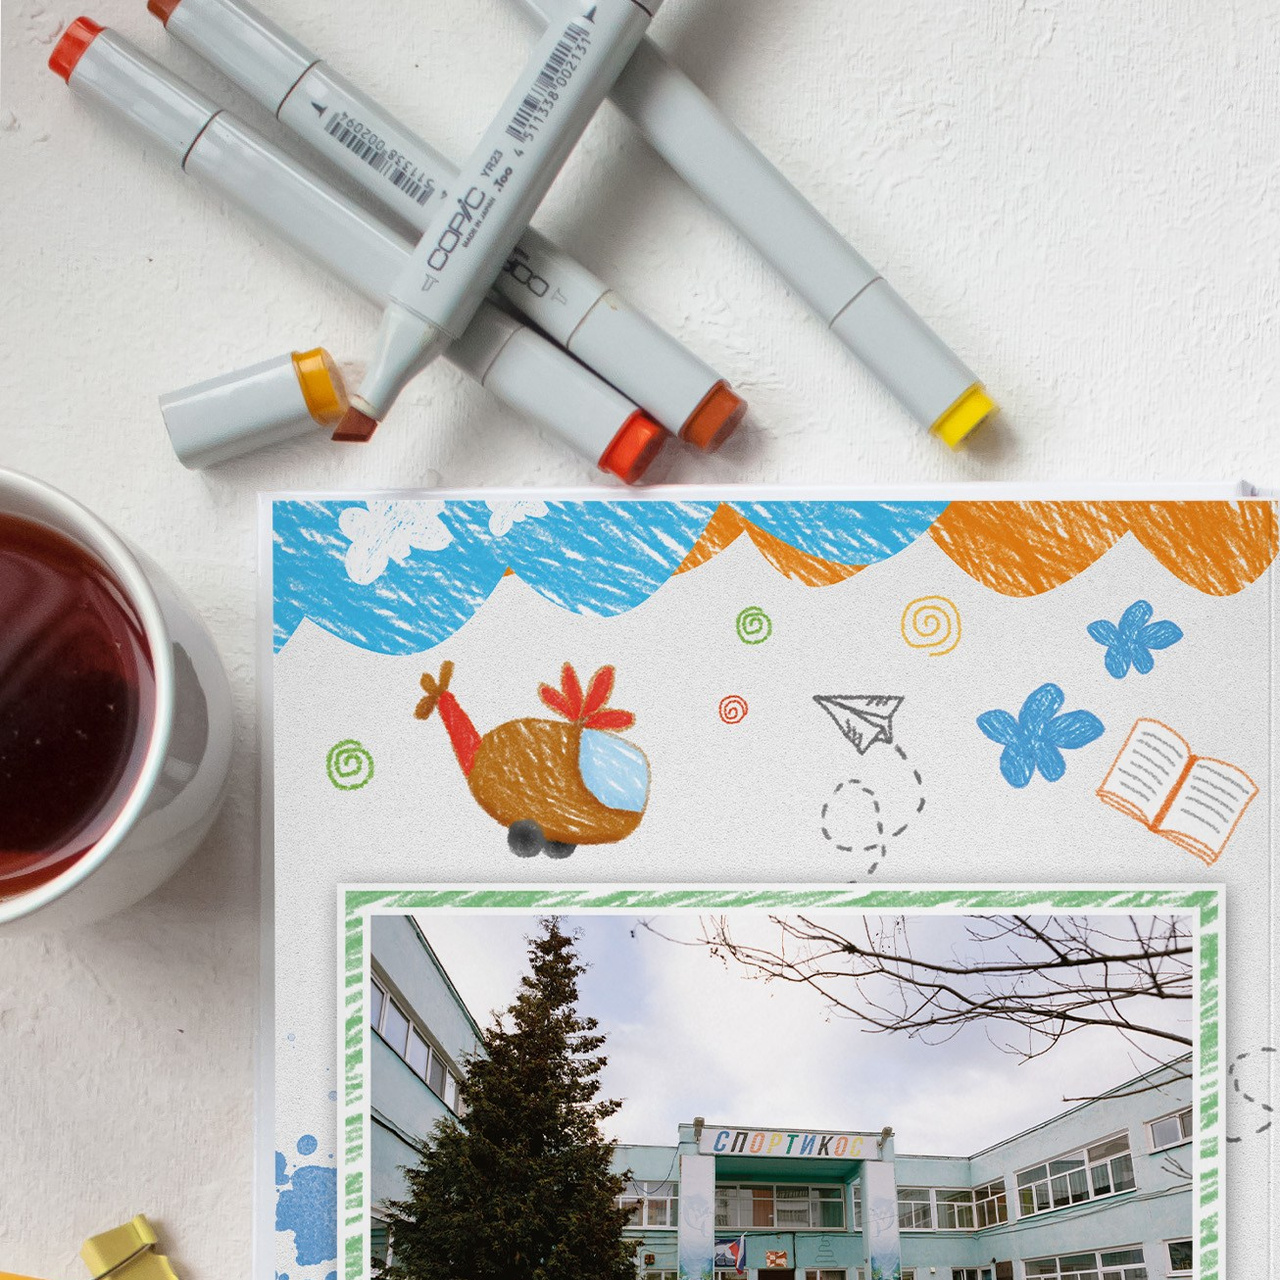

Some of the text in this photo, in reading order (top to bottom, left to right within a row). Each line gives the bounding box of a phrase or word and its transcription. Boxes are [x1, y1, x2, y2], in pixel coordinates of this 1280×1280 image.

[480, 149, 503, 178] YR23
[513, 148, 524, 158] 4
[462, 226, 479, 249] MADE
[479, 197, 497, 222] JAPAN
[713, 1130, 864, 1157] СПОРТИКОС
